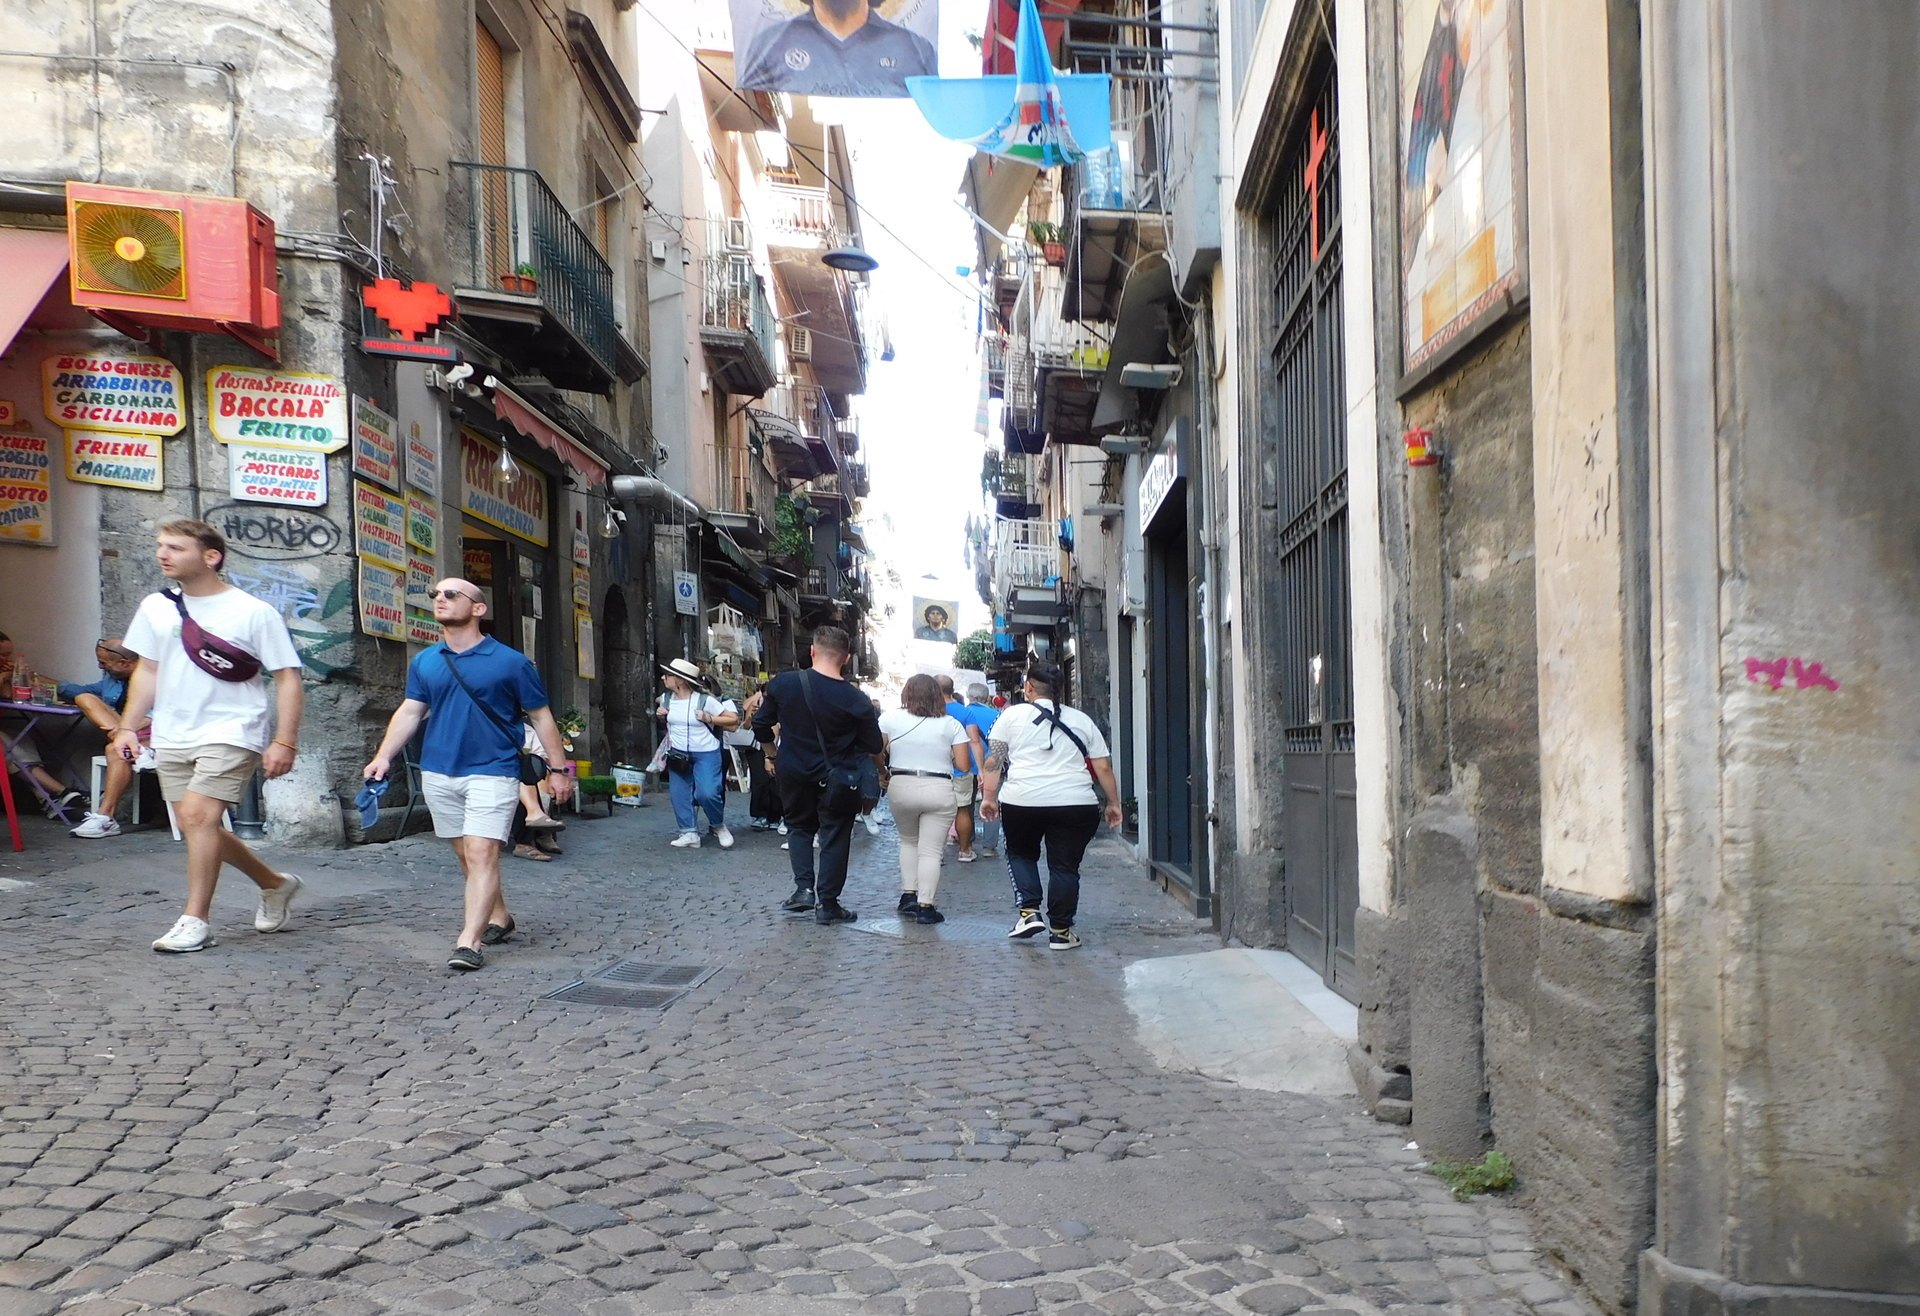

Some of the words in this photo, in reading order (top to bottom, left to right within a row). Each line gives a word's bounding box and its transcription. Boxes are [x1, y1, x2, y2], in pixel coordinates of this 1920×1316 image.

[56, 358, 174, 379] BOLOGNESE
[52, 373, 173, 395] ARRABBIATA
[215, 371, 264, 390] NOSTRA
[56, 391, 177, 410] CARBONARA
[61, 405, 178, 427] SICILIANA
[238, 419, 333, 444] FRITTO
[0, 434, 46, 451] CHERI
[242, 450, 315, 467] MAGNETS
[244, 463, 320, 481] POSTCARDS
[241, 475, 278, 486] SHOP
[291, 479, 317, 491] THE
[245, 485, 317, 501] CORNER
[363, 506, 389, 526] CALAMARI
[363, 523, 385, 540] NOSTRI
[409, 558, 435, 576] PACCHERI
[412, 571, 431, 584] OLIVE
[365, 602, 402, 624] LINGUINE
[411, 628, 440, 642] ARMENO
